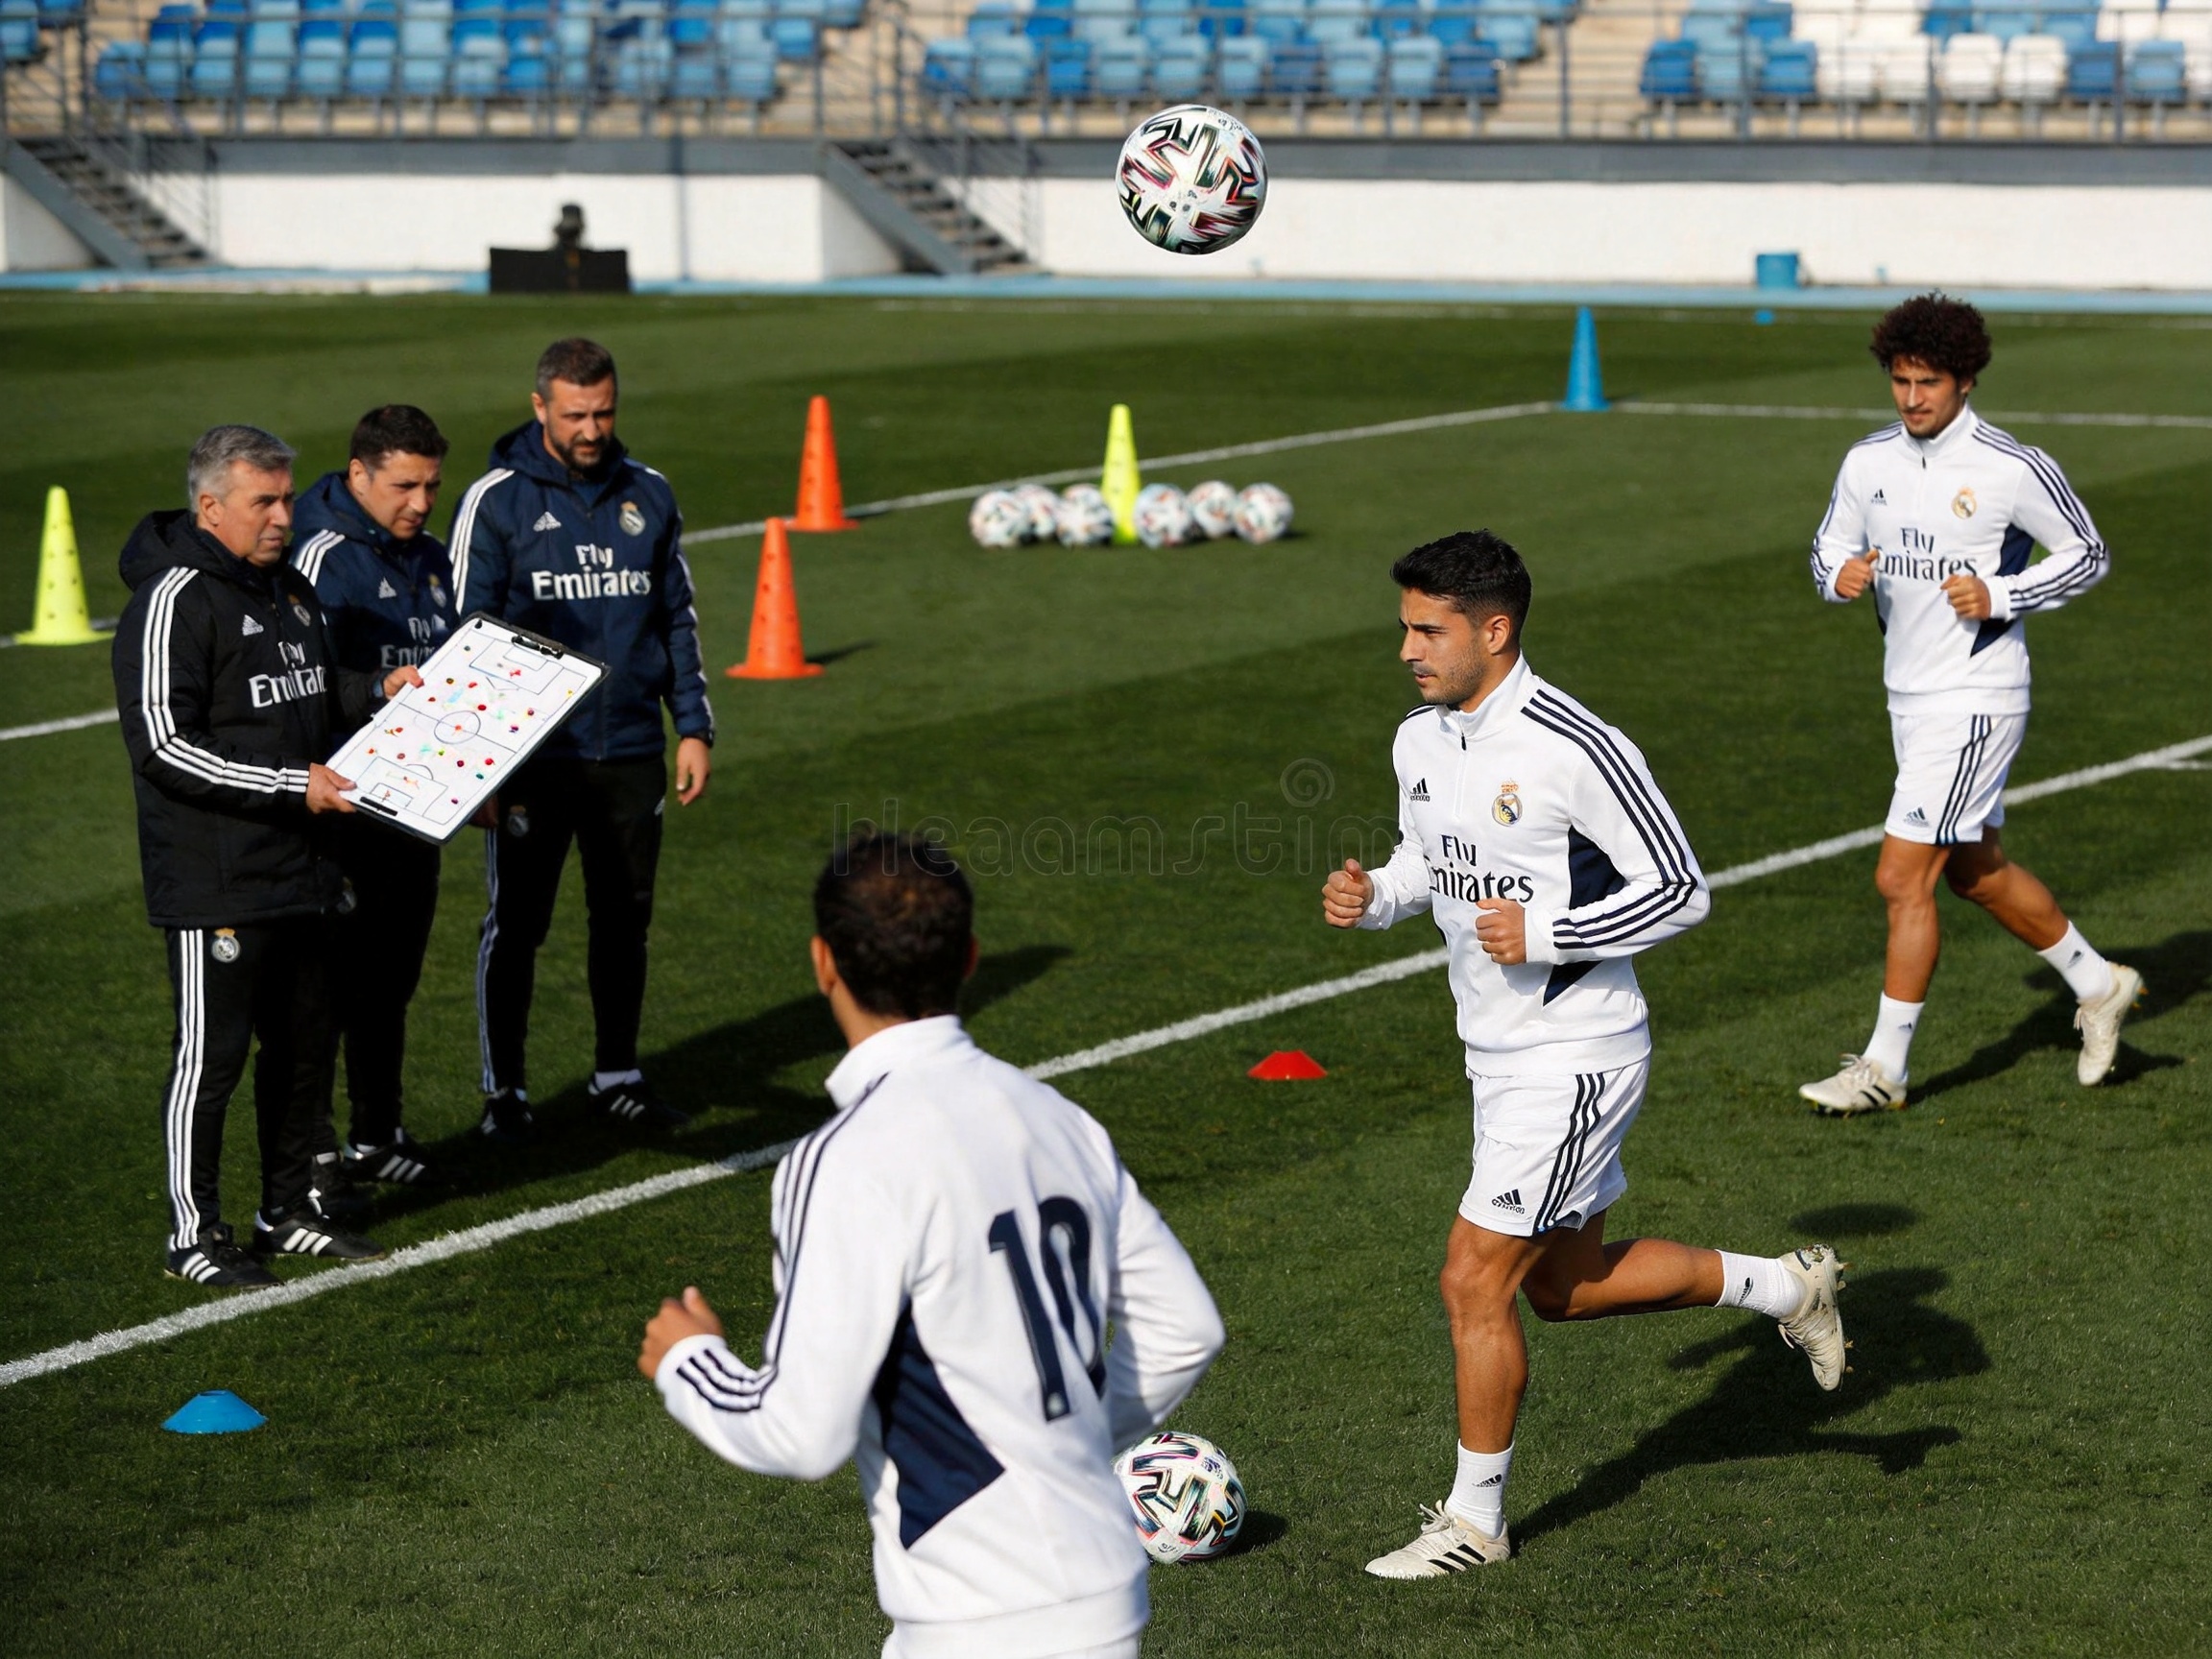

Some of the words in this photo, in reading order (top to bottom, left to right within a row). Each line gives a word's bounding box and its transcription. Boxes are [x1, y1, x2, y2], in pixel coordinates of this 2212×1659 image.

[574, 543, 613, 569] Fly
[1441, 833, 1478, 867] Fly
[987, 1195, 1107, 1423] 10
